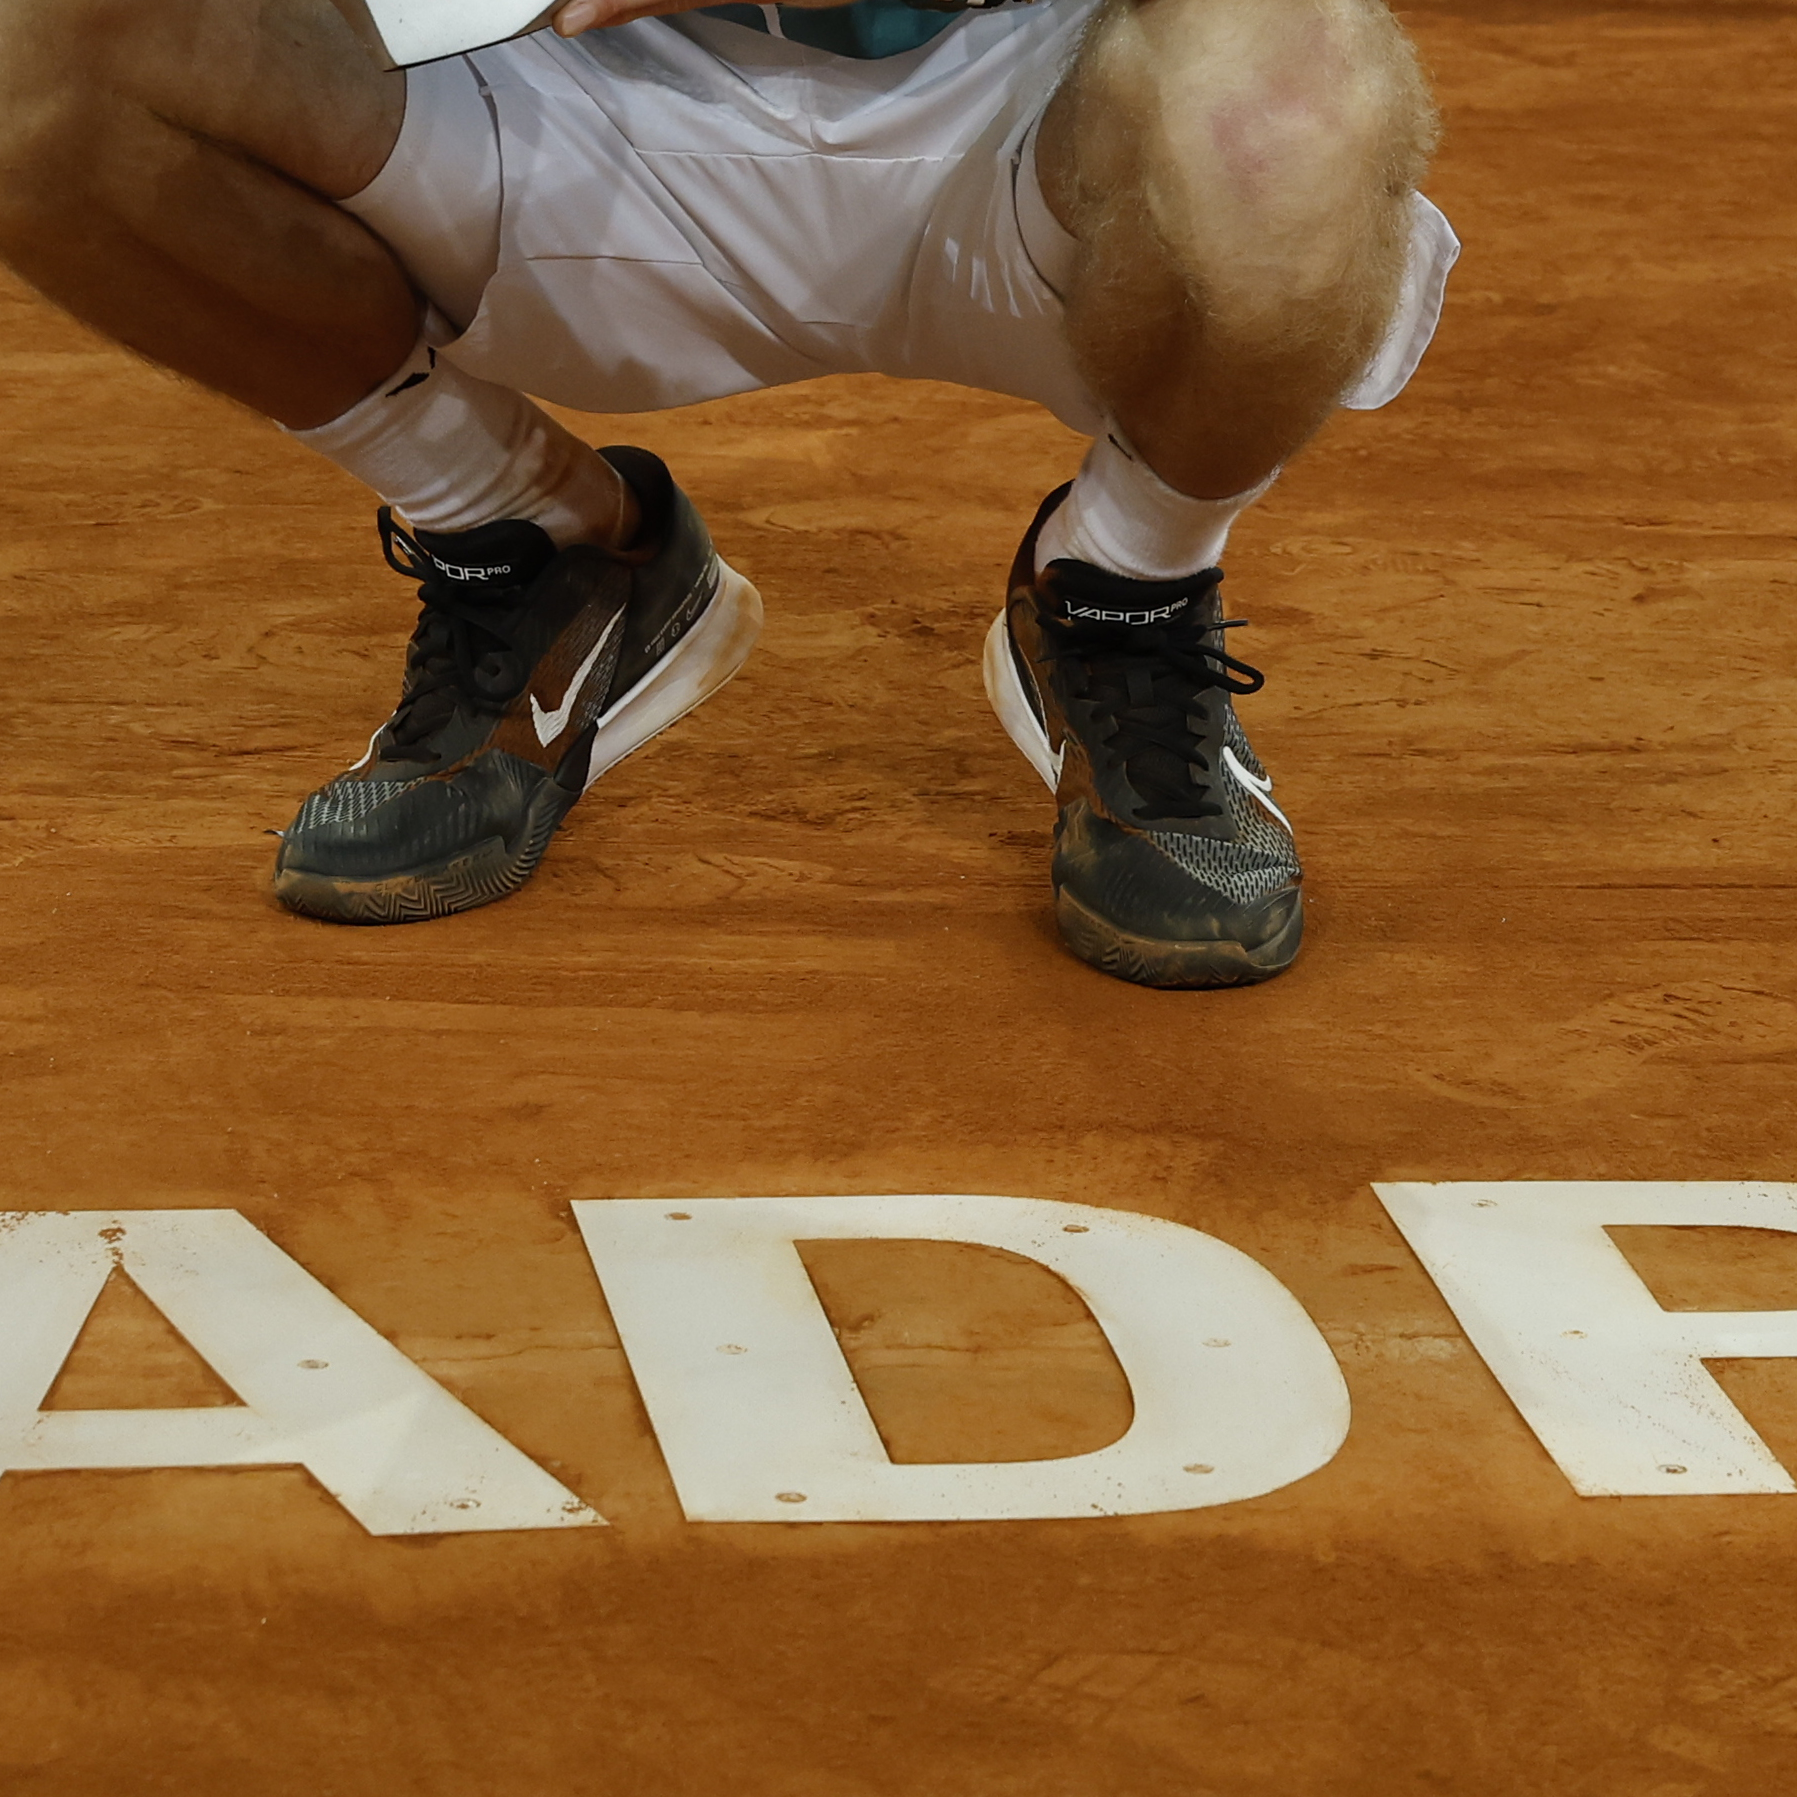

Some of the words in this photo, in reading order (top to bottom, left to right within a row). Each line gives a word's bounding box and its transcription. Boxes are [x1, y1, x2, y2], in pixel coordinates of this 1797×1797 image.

[486, 564, 512, 576] PRO
[1064, 599, 1171, 626] VAPOR
[1170, 596, 1190, 613] PRO
